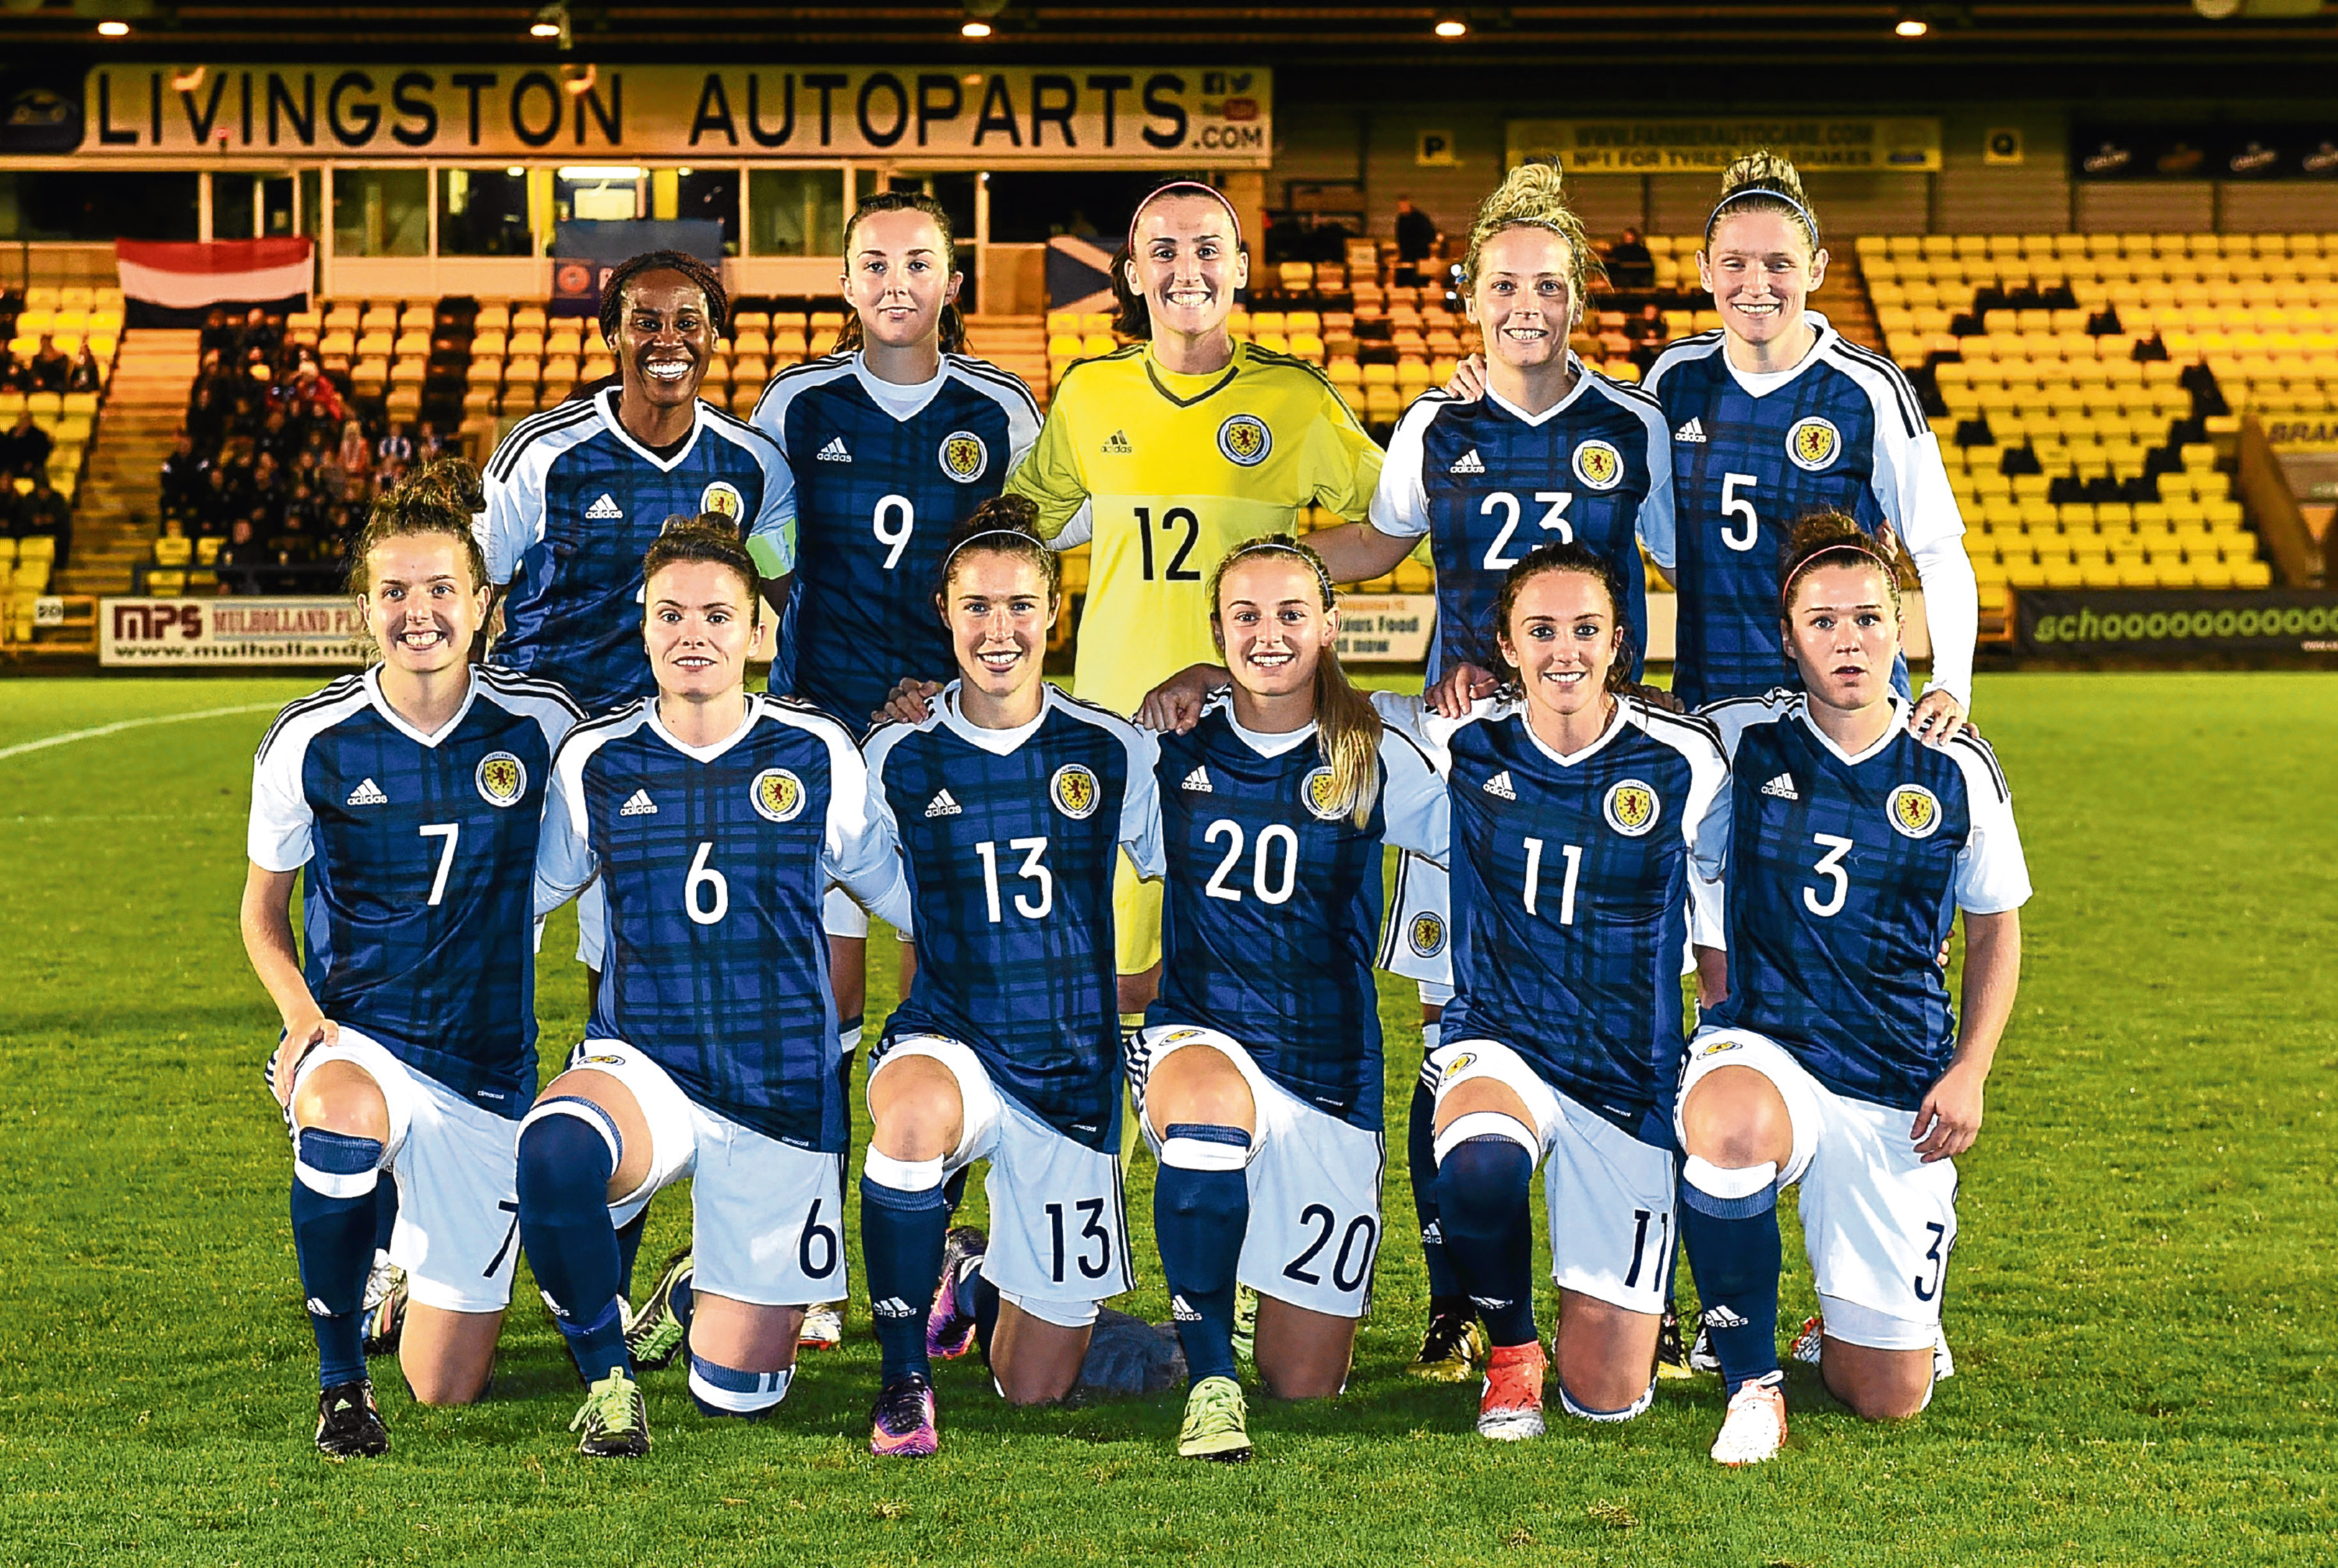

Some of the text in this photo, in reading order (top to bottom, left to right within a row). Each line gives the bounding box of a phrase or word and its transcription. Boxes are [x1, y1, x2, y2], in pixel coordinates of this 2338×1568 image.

[99, 71, 622, 148] LIVINGSTON
[689, 72, 1188, 149] AUTOPARTS
[1425, 136, 1445, 157] P
[1100, 445, 1132, 454] adidas
[1675, 433, 1707, 443] adidas
[817, 452, 852, 462] adidas
[1450, 465, 1485, 474] adidas
[585, 510, 623, 519] adidas
[1721, 472, 1758, 551] 5
[874, 495, 914, 569] 9
[1134, 507, 1201, 581] 12
[1480, 492, 1573, 570] 23
[114, 606, 203, 641] MPS
[213, 609, 330, 634] MULHOLLAND
[486, 753, 514, 765] SCOTLAND
[1061, 765, 1090, 775] SCOTLAND
[347, 795, 387, 806] adidas
[1181, 782, 1213, 793] adidas
[1482, 783, 1517, 800] adidas
[1761, 786, 1799, 800] adidas
[620, 805, 658, 816] adidas
[924, 805, 962, 818] adidas
[419, 823, 459, 906] 7
[976, 836, 1052, 923] 13
[1204, 819, 1298, 905] 20
[1803, 832, 1853, 917] 3
[685, 842, 729, 924] 6
[1523, 837, 1583, 925] 11
[477, 1090, 504, 1100] climacool
[782, 1136, 809, 1147] climacool
[482, 1200, 519, 1278] 7
[800, 1198, 837, 1280] 6
[1045, 1198, 1111, 1282] 13
[1283, 1203, 1376, 1292] 20
[1421, 1234, 1443, 1245] adid
[1624, 1210, 1668, 1292] 11
[1914, 1221, 1944, 1302] 3
